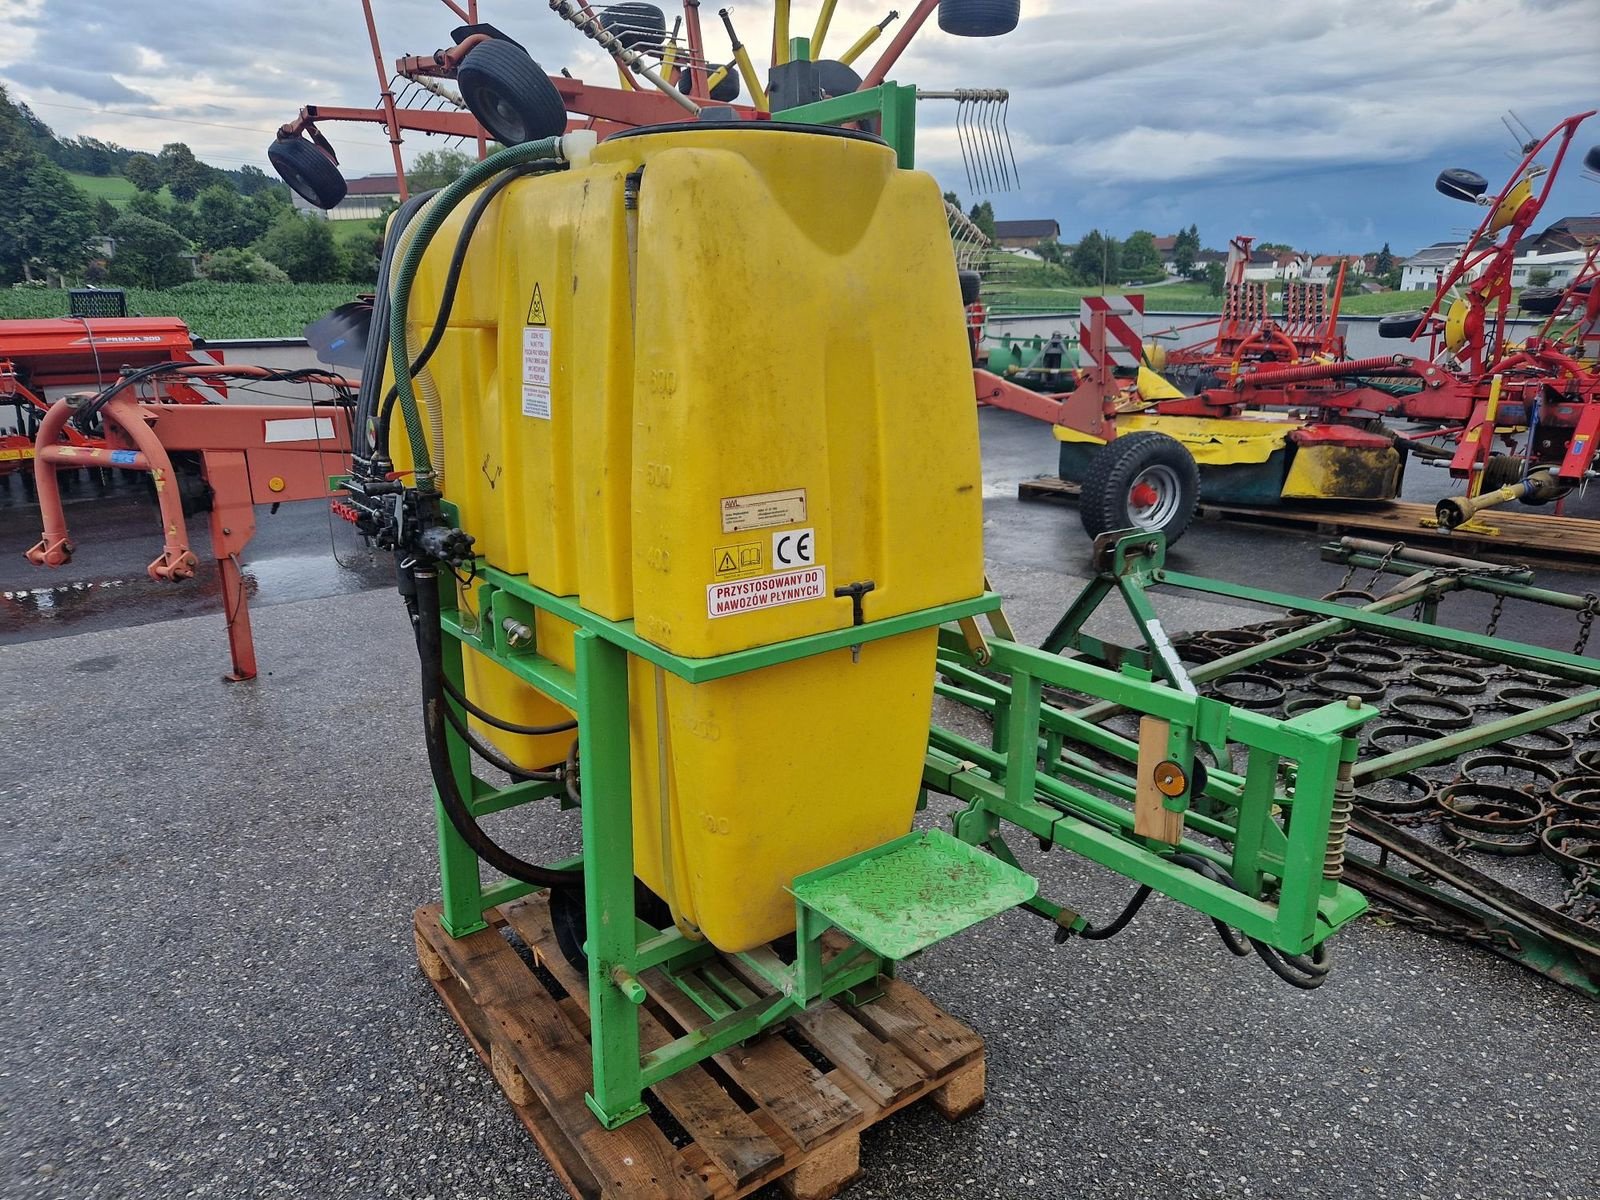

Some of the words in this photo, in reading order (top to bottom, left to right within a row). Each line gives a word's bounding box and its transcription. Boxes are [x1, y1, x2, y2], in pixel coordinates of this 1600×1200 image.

[777, 533, 810, 564] CE
[717, 574, 803, 599] PRZYSTOSOWANY
[805, 572, 818, 583] DO
[717, 594, 768, 613] NAWOZÓW
[771, 585, 819, 602] PŁYNNYCH
